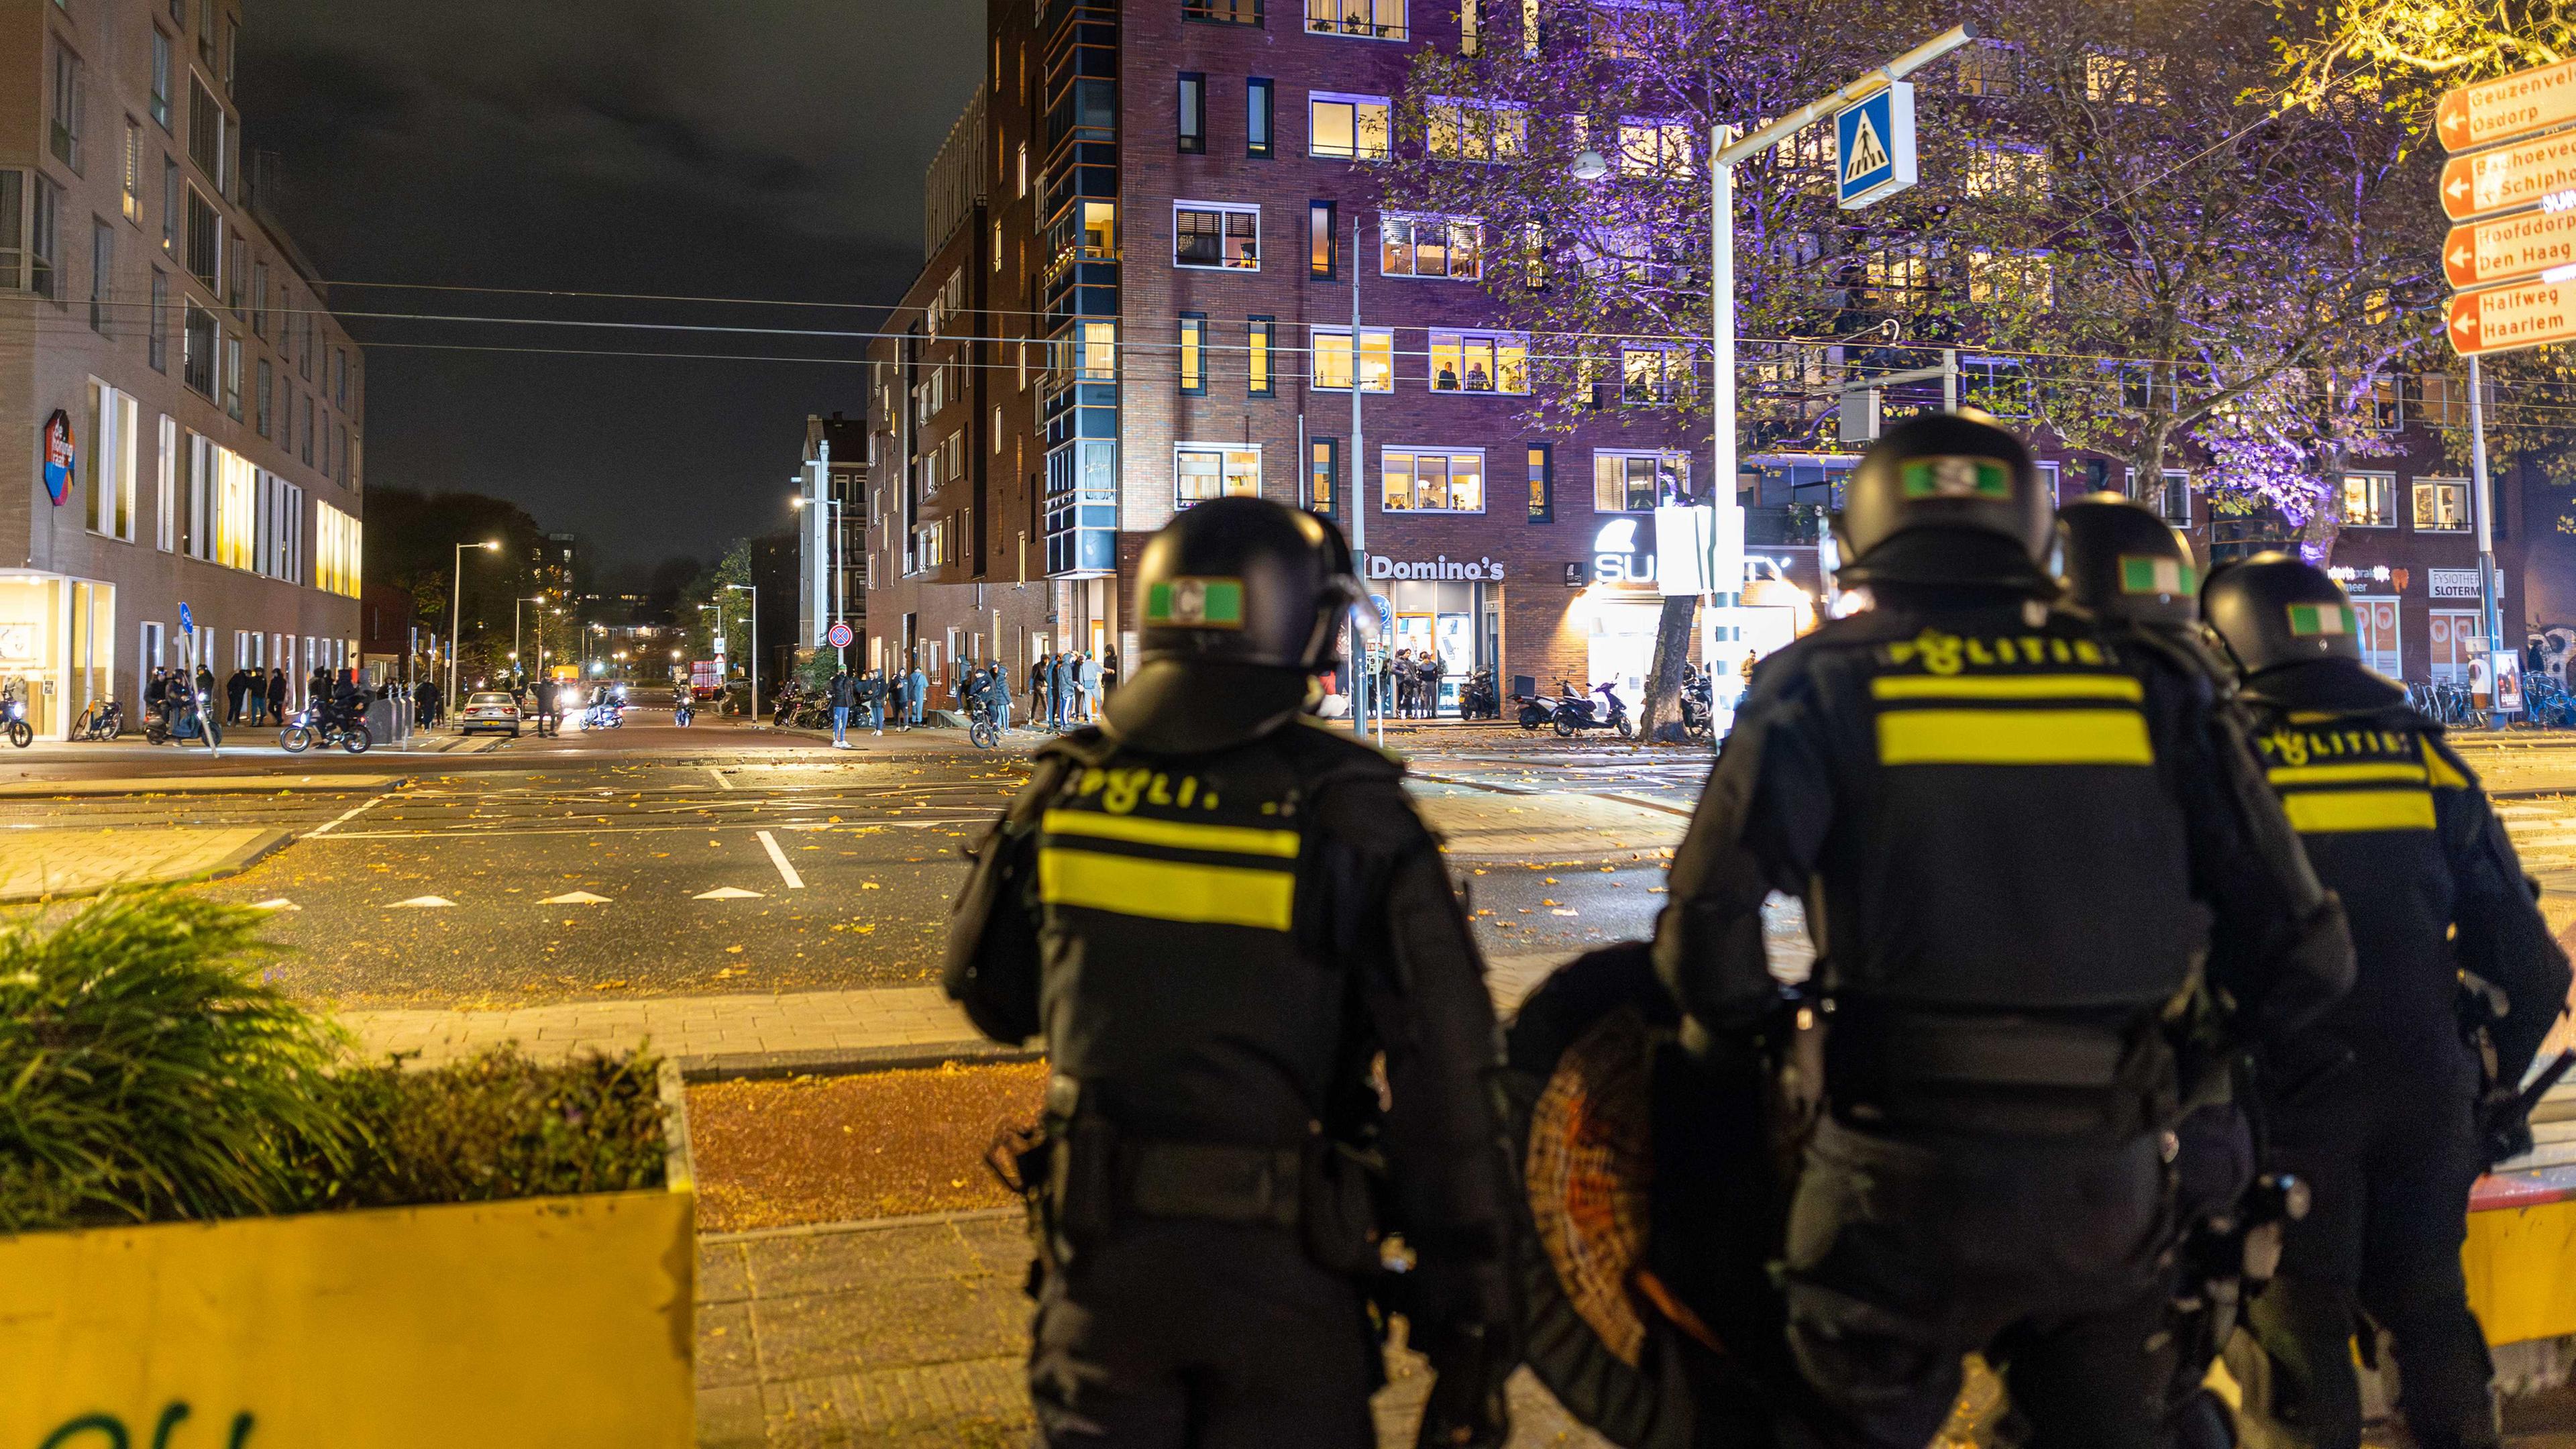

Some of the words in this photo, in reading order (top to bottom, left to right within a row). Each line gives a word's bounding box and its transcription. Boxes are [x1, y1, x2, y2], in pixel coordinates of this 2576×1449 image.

[2471, 65, 2576, 107] Geuzenvel
[2473, 106, 2538, 133] Osdorp
[2476, 142, 2576, 176] Bahoeve
[2479, 214, 2576, 246] Hoofddorp
[2480, 253, 2514, 271] Den
[2522, 242, 2571, 264] Haag
[2483, 288, 2559, 312] Halfweg
[2484, 314, 2565, 338] Haarlem
[1595, 554, 1655, 583] SU
[2434, 574, 2498, 586] FYSIOTHER
[2434, 586, 2496, 596] SLOTERM
[1888, 628, 2103, 676] POLITIE
[1078, 767, 1277, 815] POLI
